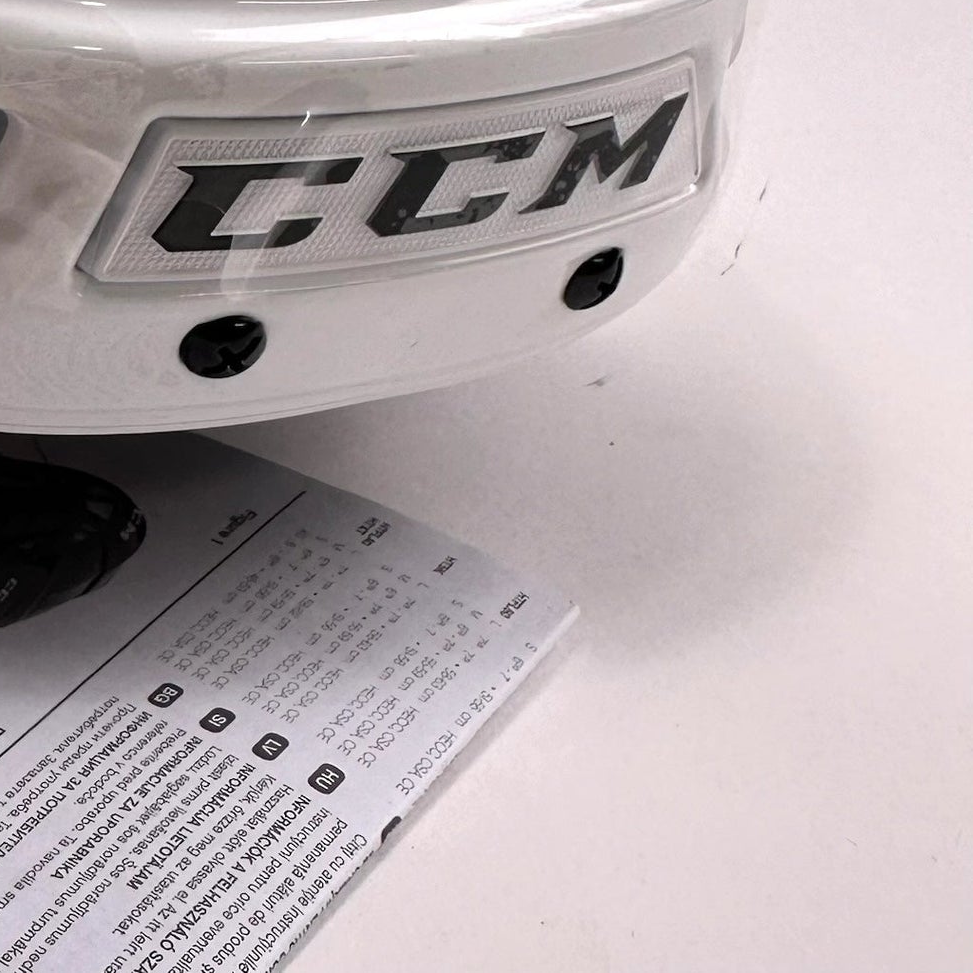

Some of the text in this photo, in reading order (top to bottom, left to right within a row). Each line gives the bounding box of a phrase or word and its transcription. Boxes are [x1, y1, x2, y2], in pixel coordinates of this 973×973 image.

[151, 91, 690, 253] CCM
[155, 685, 179, 704] BG
[207, 712, 228, 728] SI
[261, 738, 283, 756] LV
[60, 775, 82, 791] ЗА
[315, 768, 340, 789] HU
[50, 735, 203, 879] INFORMACIJE ZA UPORABNIKA
[229, 860, 246, 873] A
